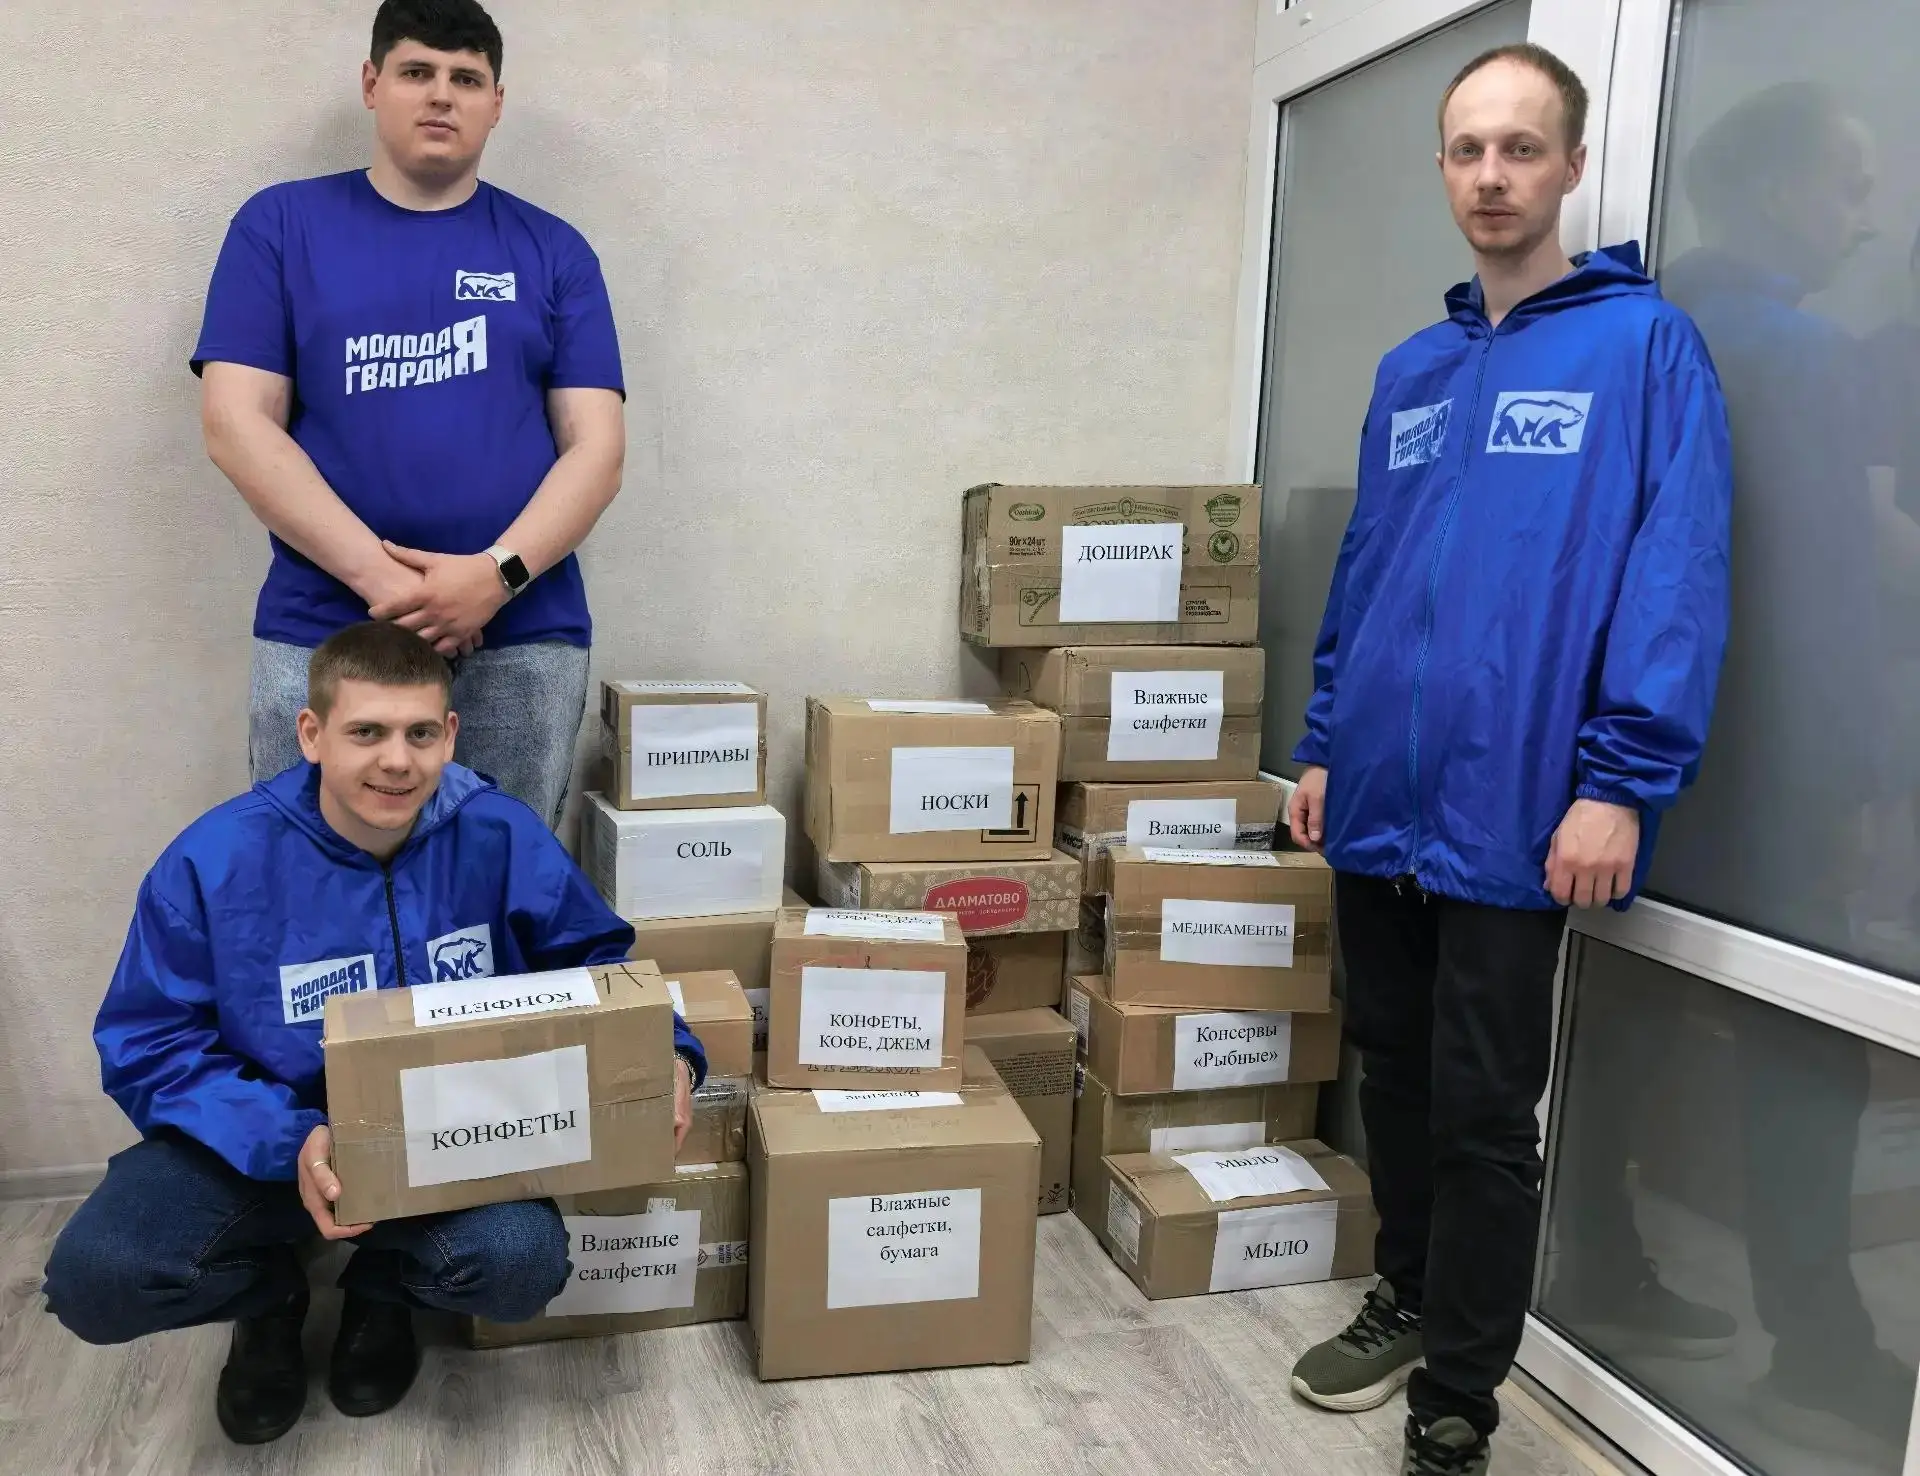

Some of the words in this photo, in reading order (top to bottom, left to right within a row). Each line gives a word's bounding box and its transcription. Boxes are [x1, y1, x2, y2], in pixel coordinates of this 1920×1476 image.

[1078, 544, 1173, 564] ДОШИРАК
[1134, 689, 1208, 705] Влажные
[1133, 714, 1207, 733] салфетки
[647, 747, 750, 767] ПРИПРАВЫ
[921, 794, 989, 811] НОСКИ
[1148, 820, 1222, 836] Влажные
[677, 841, 732, 859] СОЛЬ
[935, 892, 1020, 909] ДАЛМАТОВО
[1171, 921, 1288, 936] МЕДИКАМЕНТЫ
[429, 990, 573, 1020] КОНФЕТЫ
[830, 1014, 922, 1031] КОНФЕТЫ,
[819, 1035, 872, 1051] КОФЕ,
[876, 1037, 931, 1053] ДЖЕМ
[1196, 1025, 1278, 1045] Консервы
[1193, 1051, 1278, 1069] «Рыбные»
[431, 1109, 577, 1151] КОНФЕТЫ
[1215, 1154, 1279, 1170] МЫЛО
[870, 1195, 951, 1214] Влажные
[866, 1219, 952, 1239] салфетки,
[580, 1233, 679, 1252] Влажные
[1242, 1238, 1309, 1261] МЫЛО
[880, 1243, 939, 1264] бумага
[578, 1262, 677, 1283] салфетки
